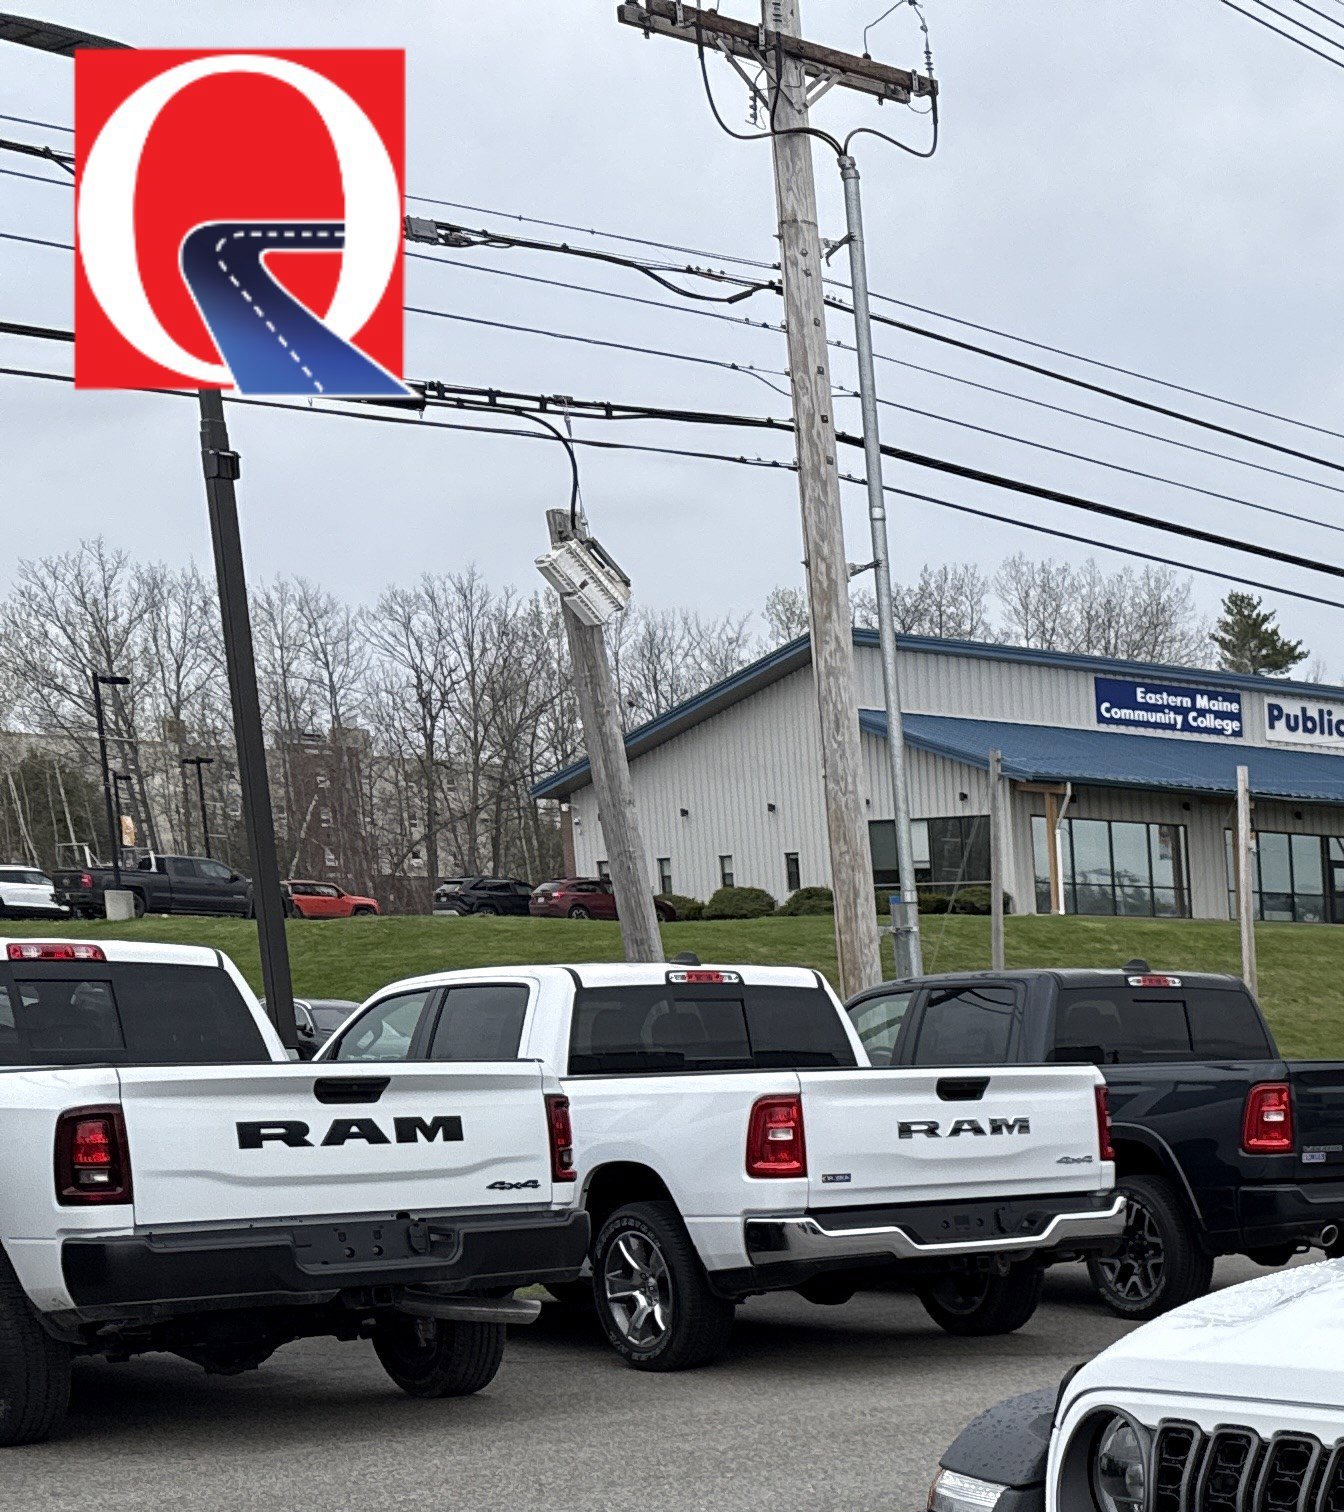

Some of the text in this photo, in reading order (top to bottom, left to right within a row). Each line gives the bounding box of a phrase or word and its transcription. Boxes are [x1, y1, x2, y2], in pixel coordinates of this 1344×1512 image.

[1135, 687, 1240, 713] Eastern Maine
[1100, 702, 1241, 735] Community College
[235, 1115, 465, 1150] RAM
[897, 1116, 1032, 1141] RAM
[486, 1179, 540, 1190] 4x4
